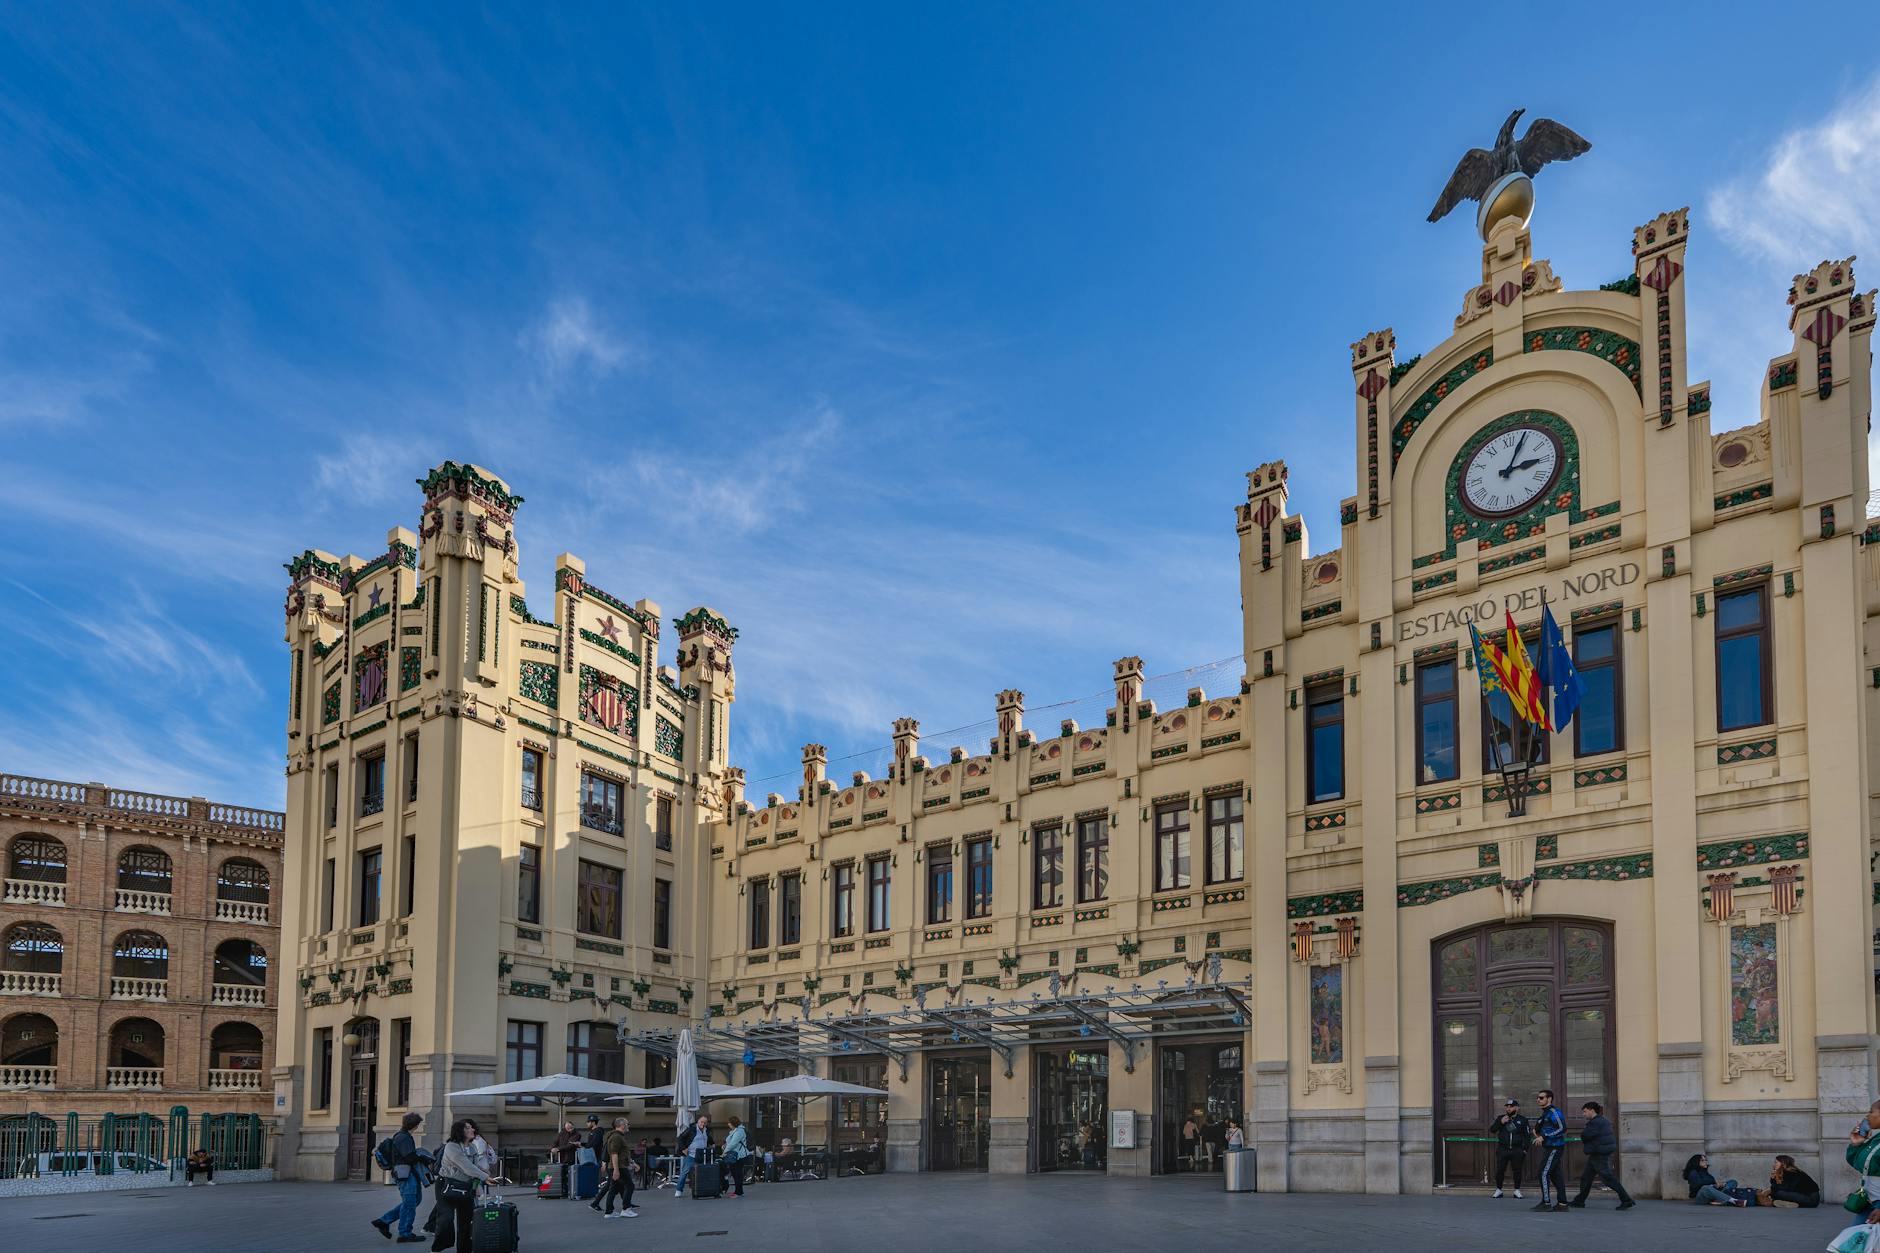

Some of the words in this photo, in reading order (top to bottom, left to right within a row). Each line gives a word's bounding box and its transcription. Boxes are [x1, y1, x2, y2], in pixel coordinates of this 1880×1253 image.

[1502, 436, 1515, 449] XII
[1486, 446, 1498, 458] XI
[1475, 462, 1486, 470] X
[1399, 594, 1497, 642] ESTACIÓ
[1504, 585, 1557, 616] DEL
[1561, 562, 1641, 601] NORD
